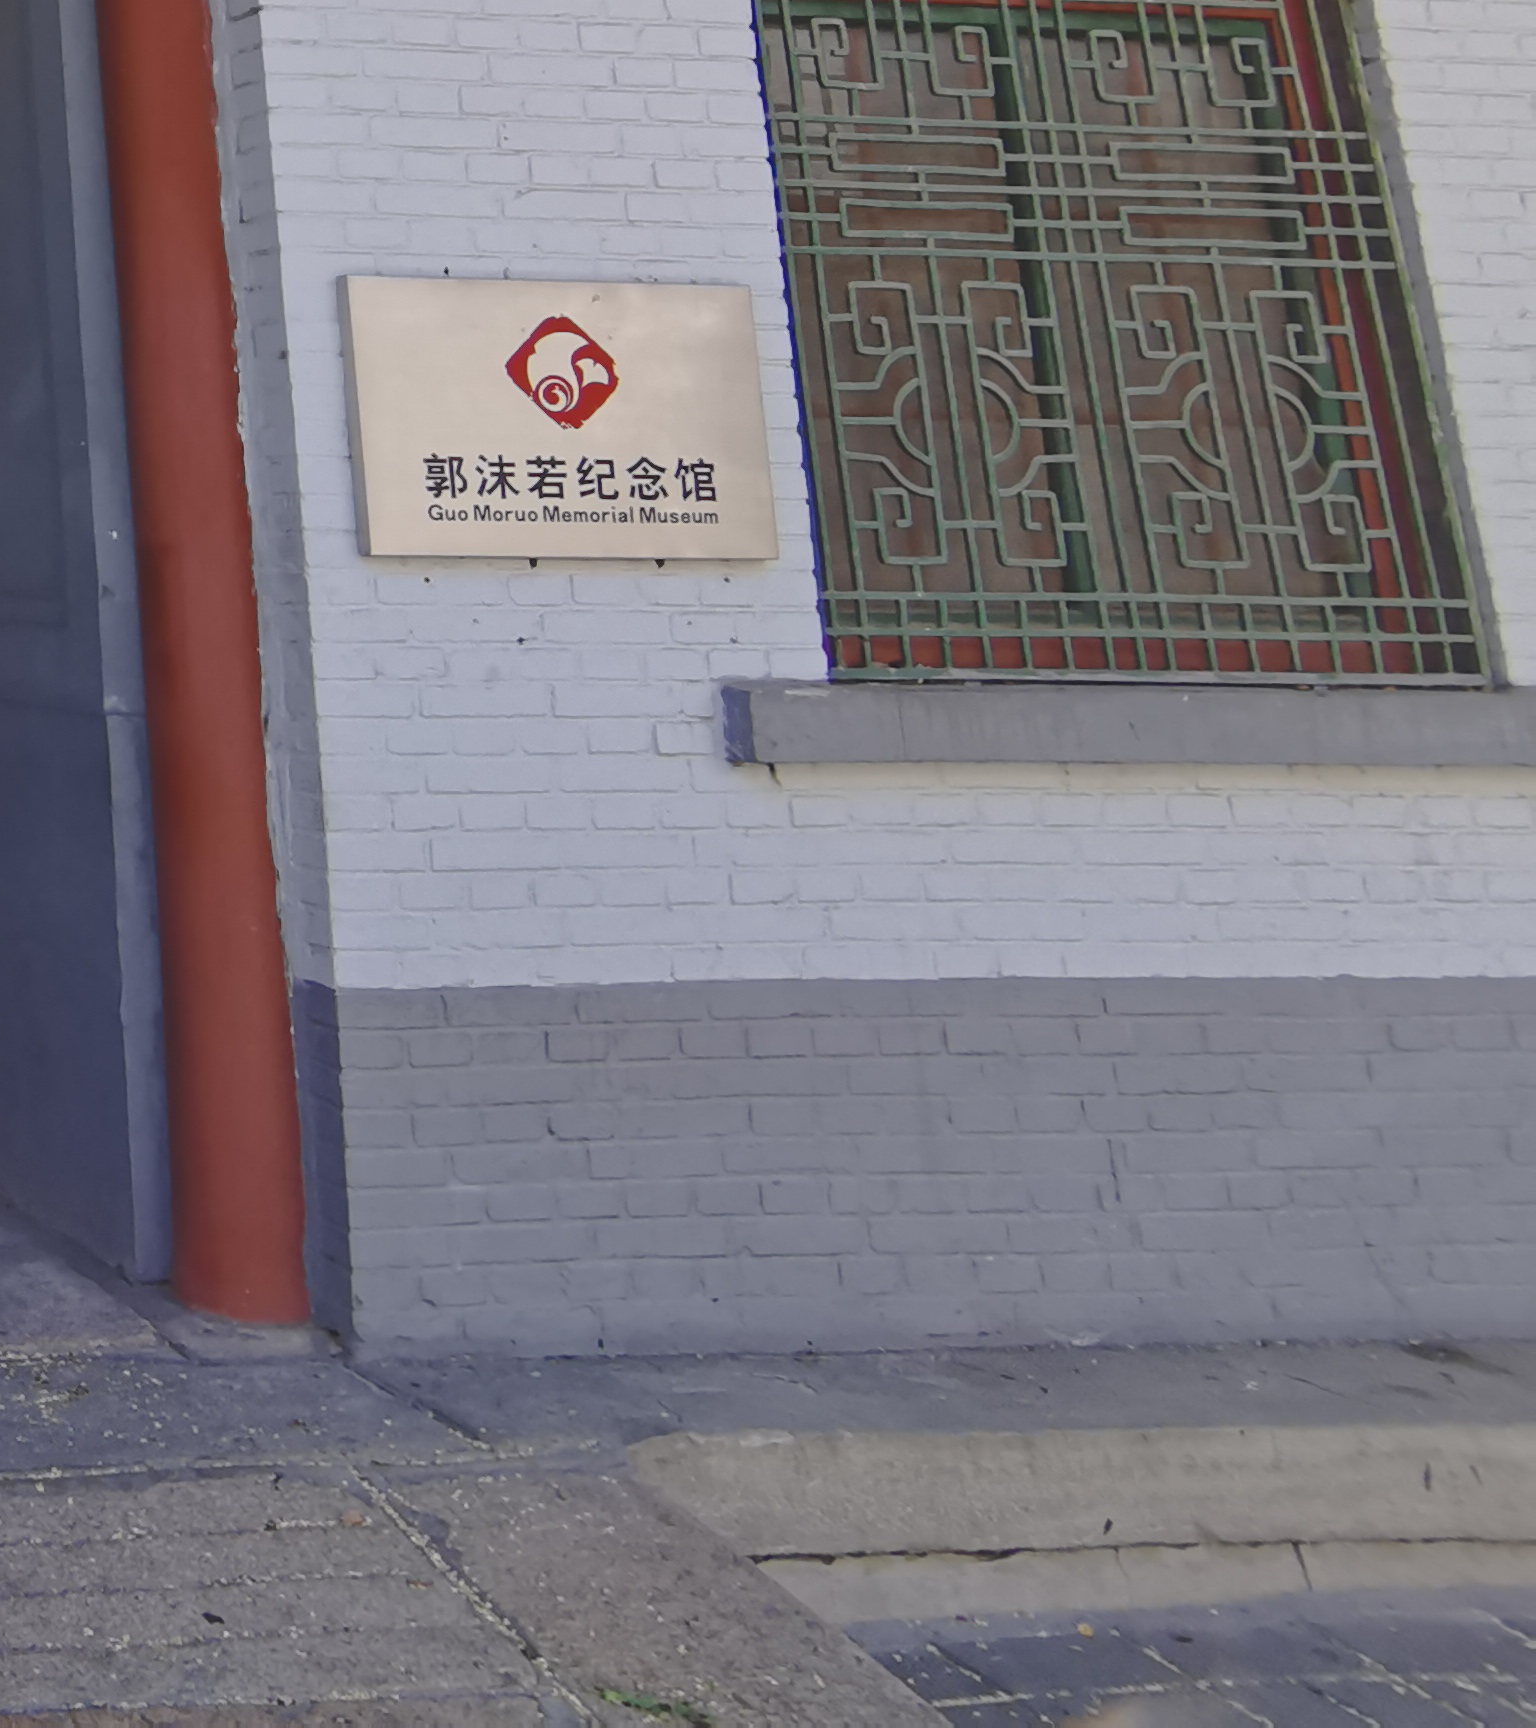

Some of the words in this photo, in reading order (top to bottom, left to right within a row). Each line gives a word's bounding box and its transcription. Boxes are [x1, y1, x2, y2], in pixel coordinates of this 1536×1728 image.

[423, 452, 718, 502] 郭沫若纪念馆
[427, 503, 468, 523] Guo
[473, 504, 539, 523] Moruo
[543, 504, 634, 524] Memorial
[639, 505, 719, 525] Museum
